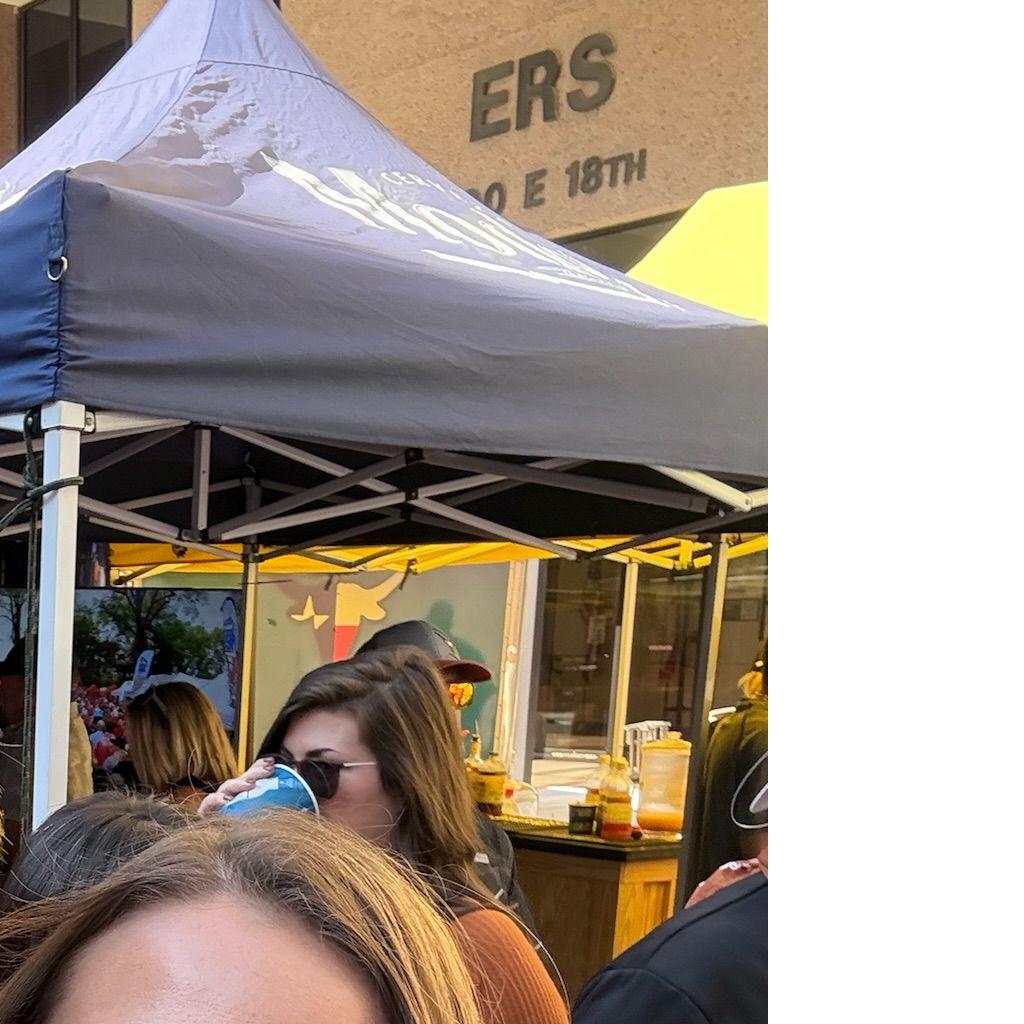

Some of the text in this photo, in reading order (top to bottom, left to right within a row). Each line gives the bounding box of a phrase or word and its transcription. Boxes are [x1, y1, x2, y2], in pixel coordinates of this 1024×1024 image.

[469, 32, 618, 143] ERS
[523, 168, 548, 209] E
[565, 148, 647, 198] 18TH
